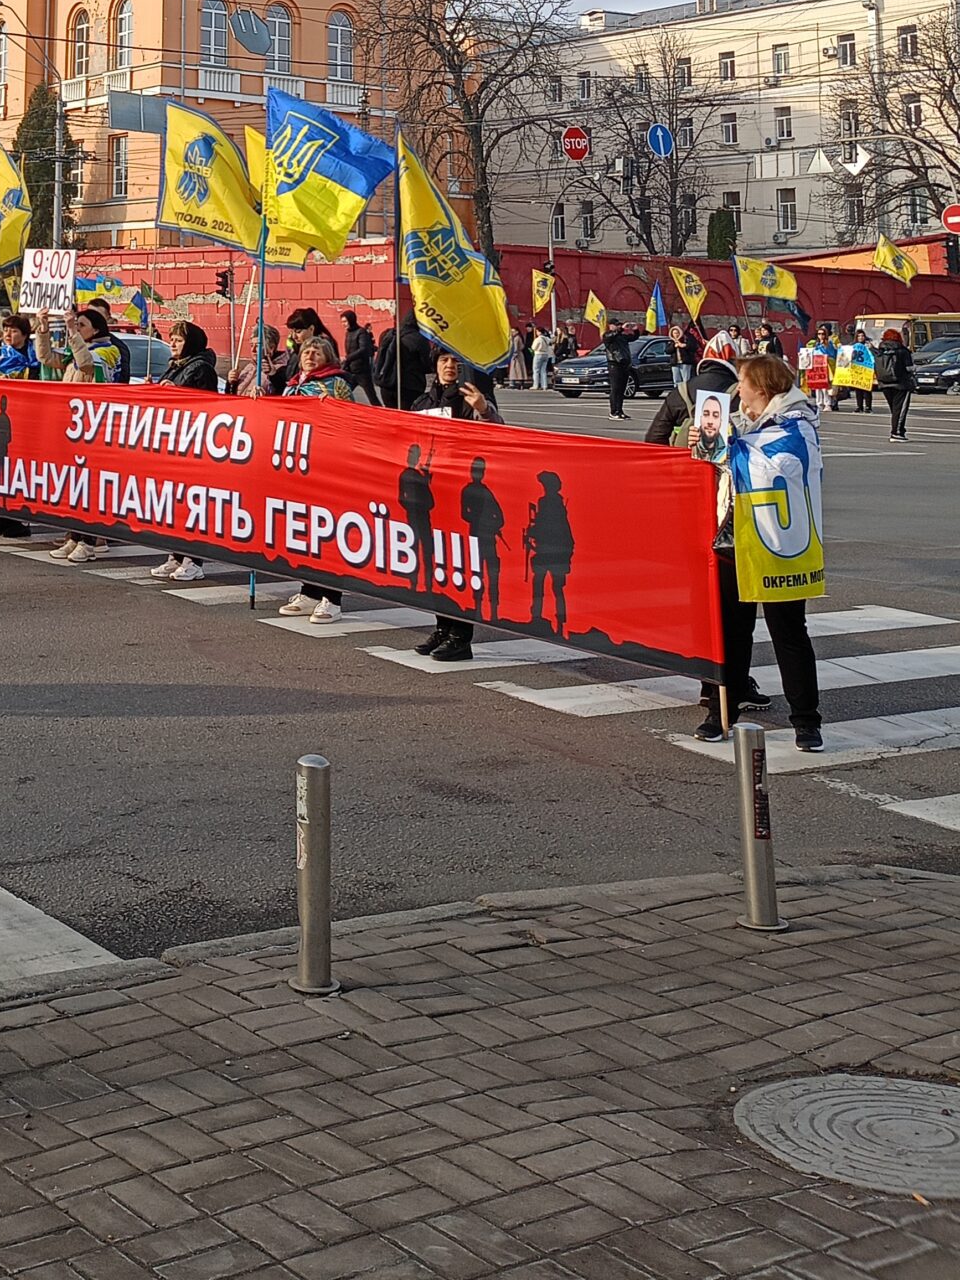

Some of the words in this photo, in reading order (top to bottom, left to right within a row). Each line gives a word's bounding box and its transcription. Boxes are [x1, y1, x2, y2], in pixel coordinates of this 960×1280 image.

[564, 138, 586, 150] STOP
[31, 250, 71, 279] 9:00
[20, 281, 70, 311] ЗУПИНИСЬ
[418, 301, 450, 333] 2022
[65, 397, 254, 462] ЗУПИНИСЬ
[271, 420, 312, 473] !!!
[98, 470, 254, 539] ПАМ'ЯТЬ
[265, 497, 418, 575] ГЕРОЇВ
[433, 529, 482, 591] !!!
[763, 572, 808, 588] ОКРЕМА
